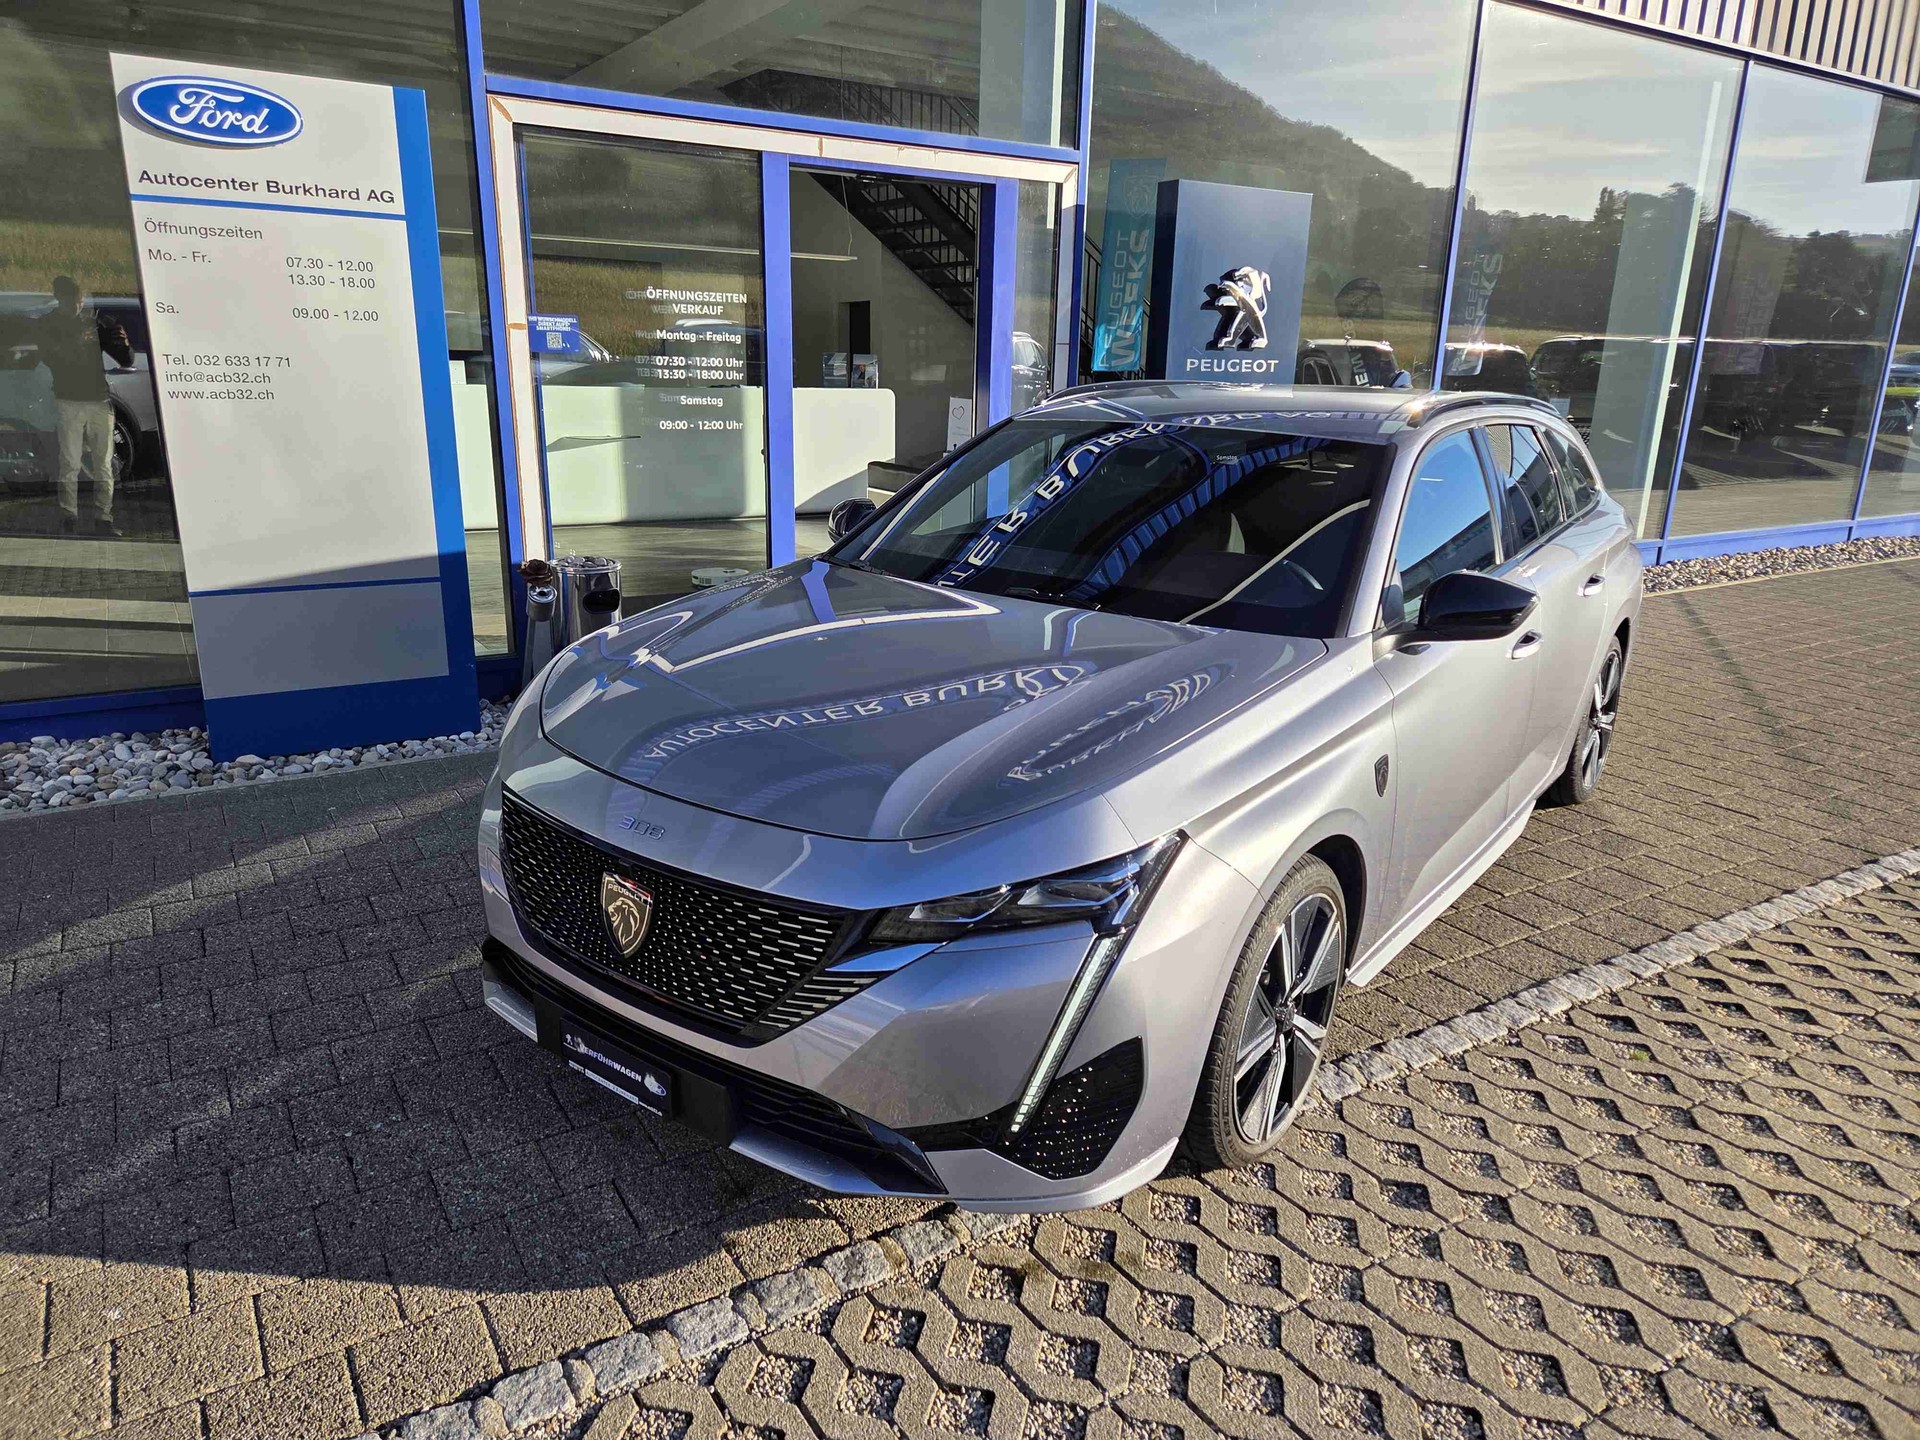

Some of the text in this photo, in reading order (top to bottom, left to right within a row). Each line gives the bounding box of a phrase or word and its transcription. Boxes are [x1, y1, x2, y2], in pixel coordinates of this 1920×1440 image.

[170, 88, 269, 134] Ford
[138, 170, 395, 204] Autocenter Burkhard AG
[144, 218, 263, 240] Öffnungszeiten
[148, 249, 177, 262] Mo.
[192, 251, 212, 264] Fr.
[286, 256, 324, 270] 07.30
[338, 259, 374, 273] 12.00
[288, 274, 326, 287] 13.30
[340, 276, 376, 289] 18.00
[646, 286, 747, 304] ÖFFNUNGSZEITEN
[1098, 229, 1129, 367] PEUGEOT
[155, 302, 180, 315] Sa.
[292, 307, 330, 320] 09.00
[343, 309, 379, 322] 12.00
[673, 303, 724, 316] VERKAUF
[656, 329, 697, 343] Montag
[706, 331, 742, 344] Freitag
[163, 353, 292, 368] Tel. 032 633 17 71
[656, 356, 686, 367] 07:30
[696, 358, 723, 368] 12:00
[726, 358, 744, 368] Uhr
[1186, 358, 1279, 373] PEUGEOT
[166, 371, 271, 384] info@acb32.ch
[657, 369, 686, 379] 13:30
[696, 370, 724, 380] 18:00
[726, 370, 744, 380] Uhr
[168, 389, 275, 400] www.acb32.ch
[680, 395, 724, 407] Samstag
[659, 420, 688, 430] 09:00
[698, 420, 724, 430] 12:00
[726, 420, 744, 430] Uhr
[619, 815, 666, 841] 308
